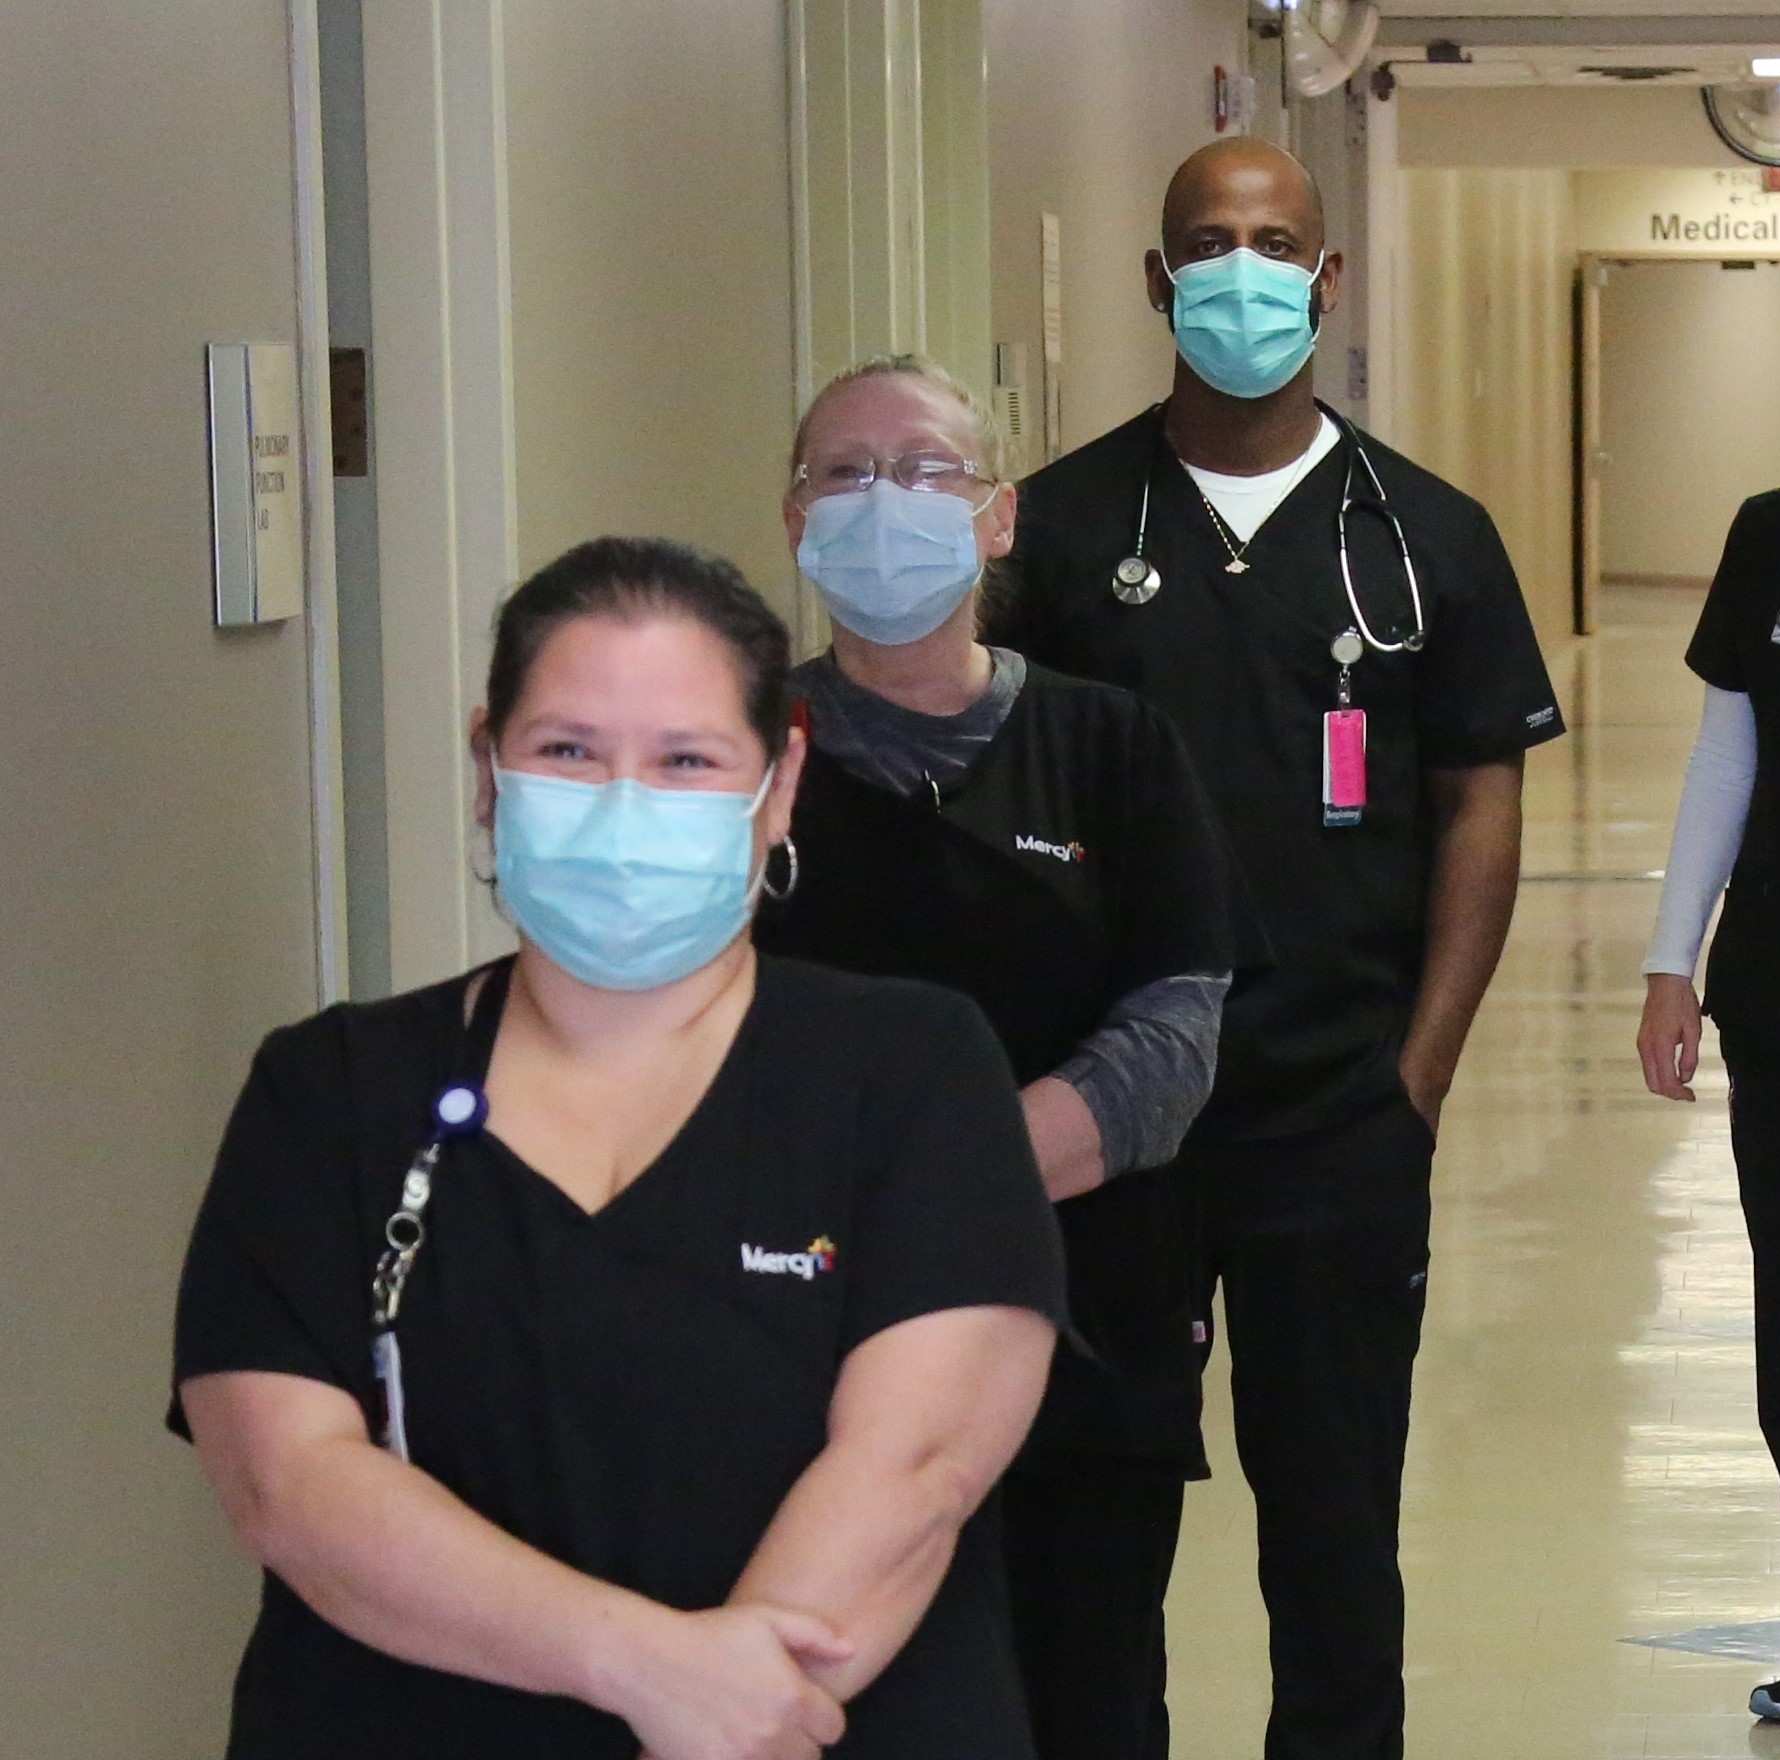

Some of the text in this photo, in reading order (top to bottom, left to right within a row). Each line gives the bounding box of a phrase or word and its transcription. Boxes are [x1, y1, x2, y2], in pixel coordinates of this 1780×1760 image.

[1651, 213, 1778, 241] Medical
[1015, 834, 1071, 861] Mercy
[741, 1242, 816, 1281] Mercy
